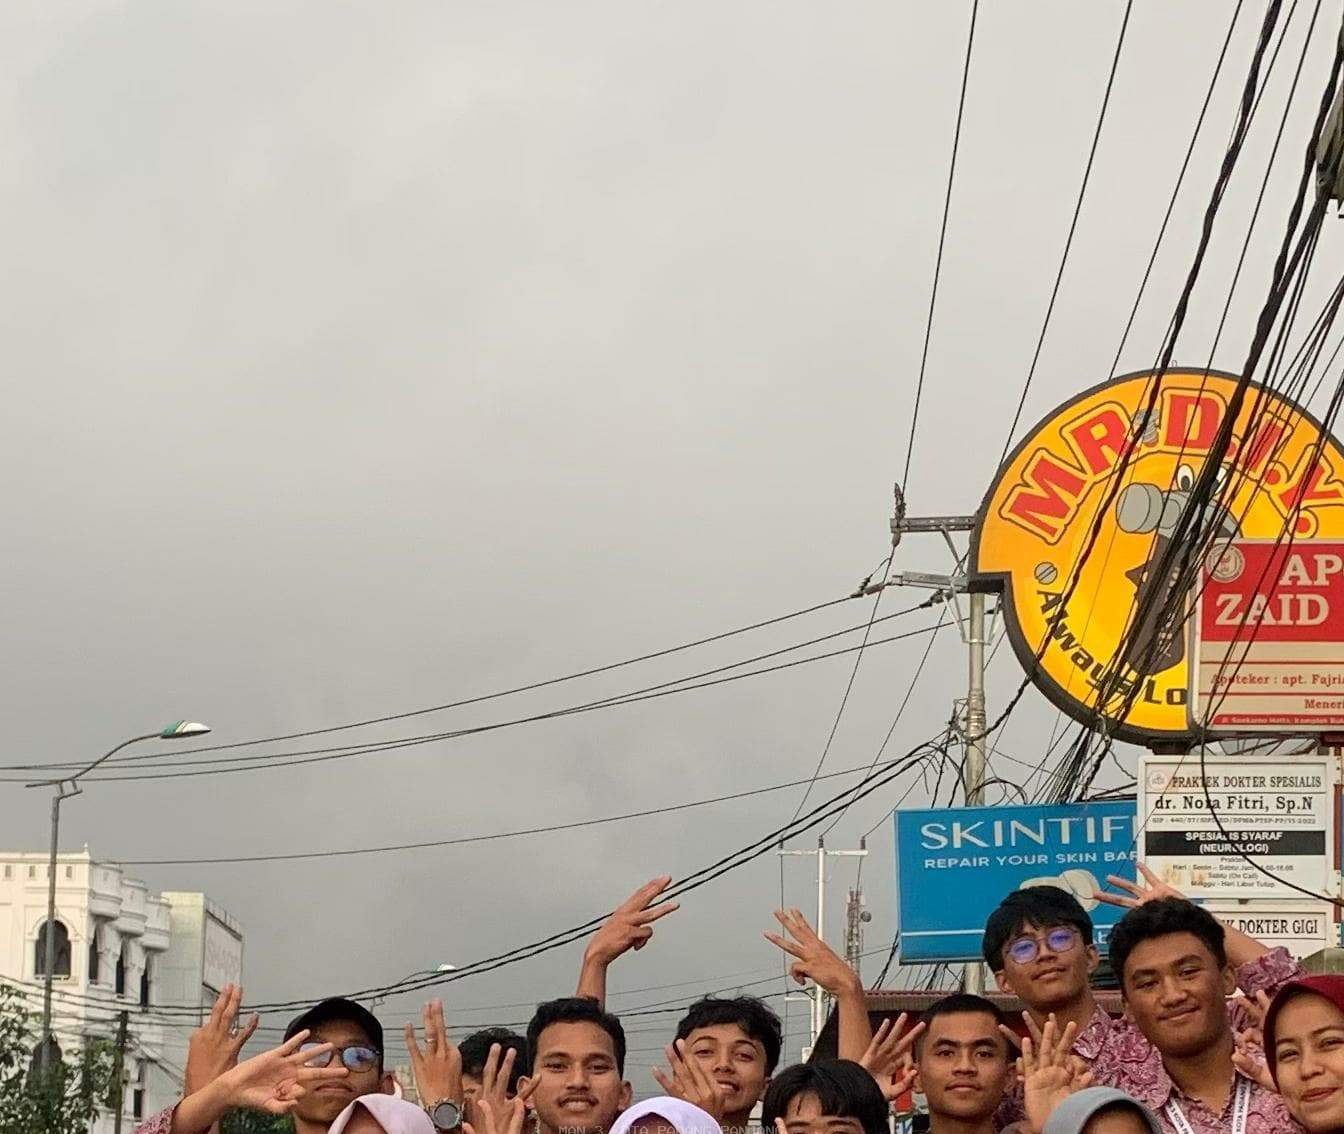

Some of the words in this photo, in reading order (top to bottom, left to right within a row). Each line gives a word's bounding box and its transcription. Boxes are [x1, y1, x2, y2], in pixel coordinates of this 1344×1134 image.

[1215, 593, 1330, 626] ZAID
[1211, 674, 1270, 686] Apoteker
[1283, 676, 1307, 687] apt.
[1172, 776, 1220, 788] PRAKTEK
[1223, 776, 1266, 788] DOKTER
[1270, 776, 1322, 788] SPESIALIS
[1156, 796, 1177, 810] dr.
[1226, 796, 1270, 811] Fitri,
[1276, 796, 1313, 812] Sp.N
[1241, 832, 1283, 841] SYARAF
[924, 856, 990, 869] REPAIR
[996, 854, 1049, 866] YOUR
[1055, 853, 1097, 864] SKIN
[1239, 919, 1289, 934] DOKTER
[1292, 919, 1318, 934] GIGI
